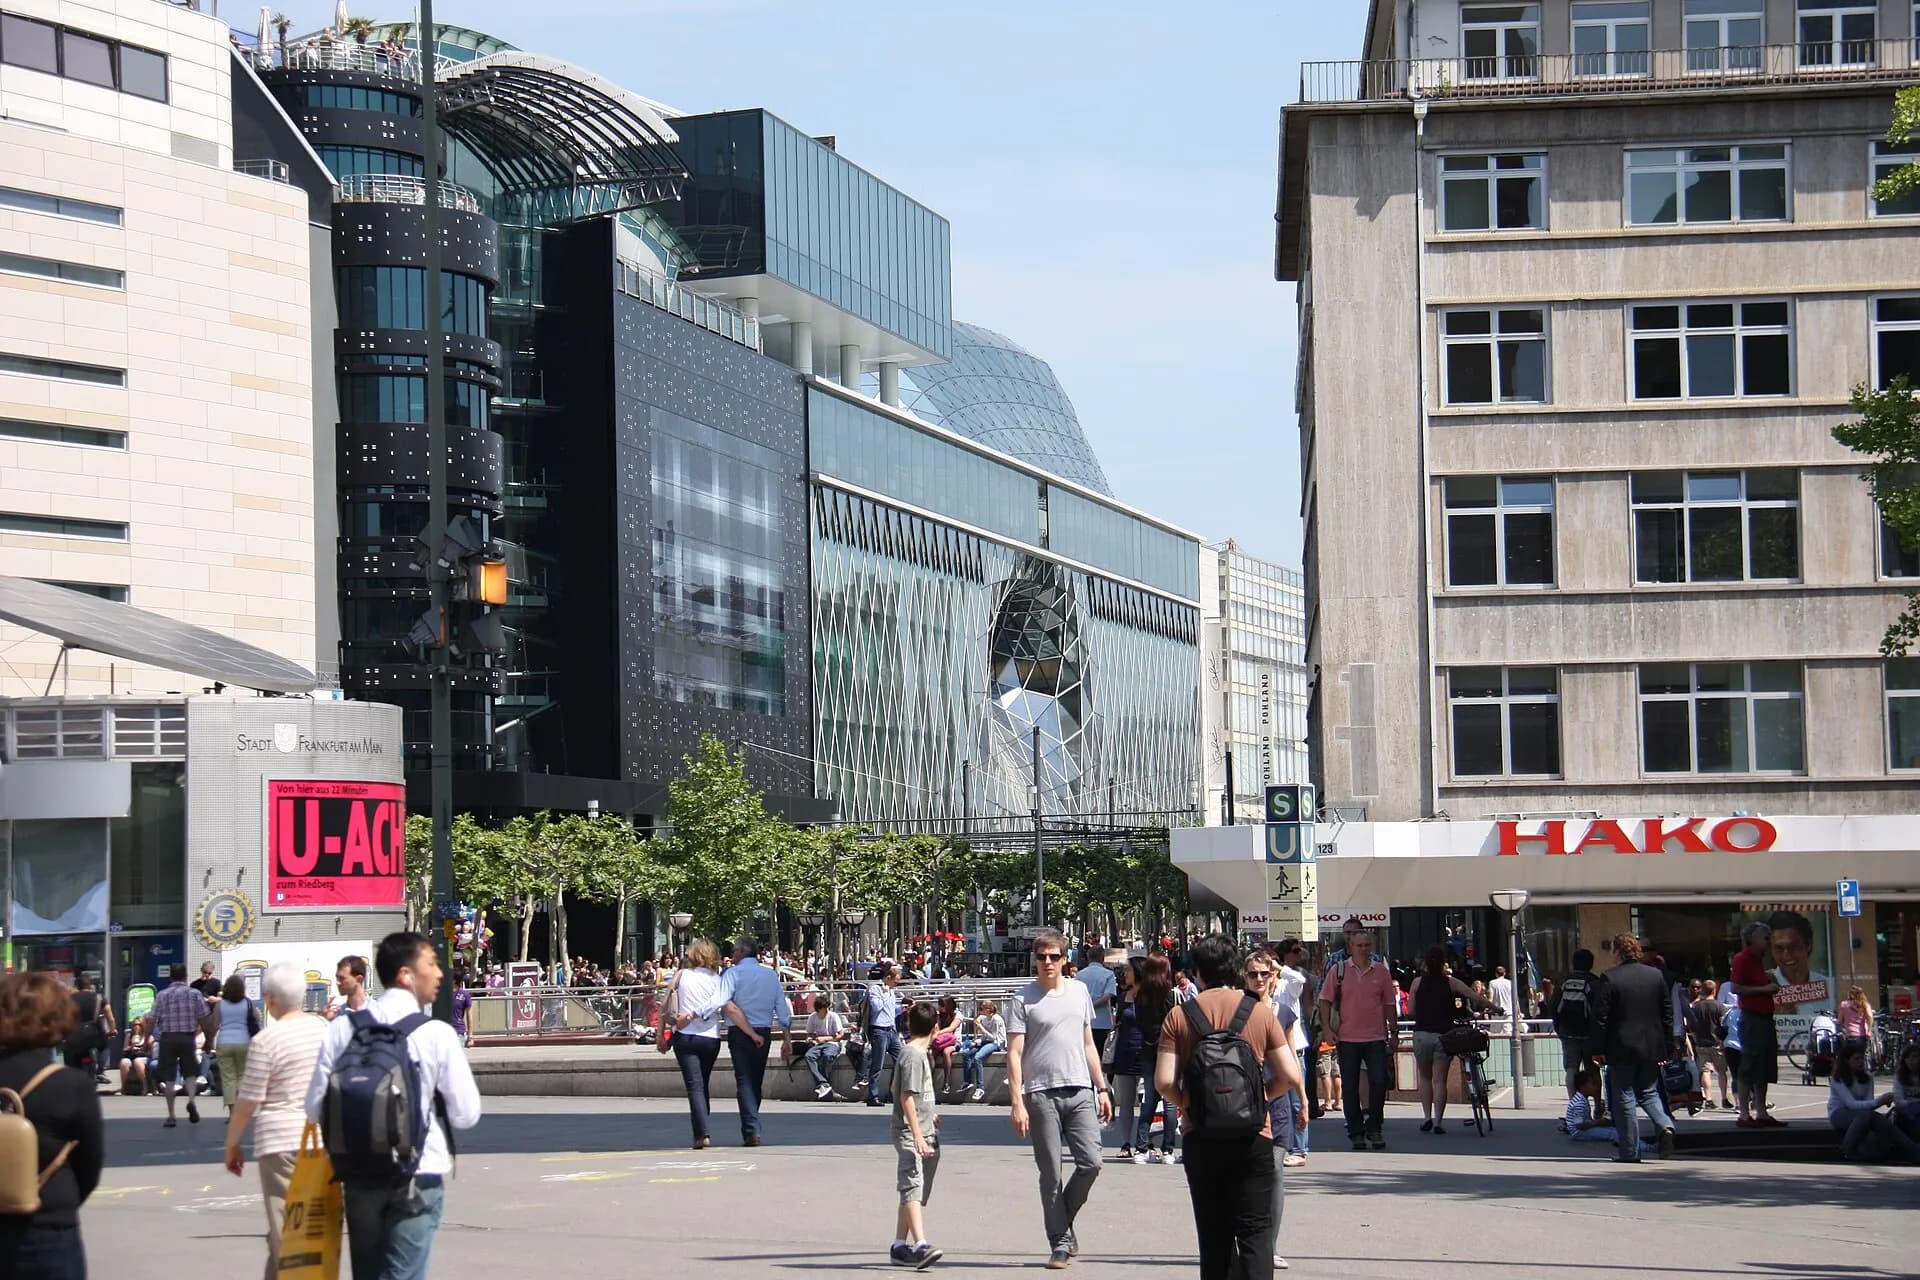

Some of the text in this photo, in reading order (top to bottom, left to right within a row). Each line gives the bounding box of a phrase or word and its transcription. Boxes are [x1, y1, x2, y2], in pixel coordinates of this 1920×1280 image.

[277, 784, 294, 793] Von
[297, 783, 313, 793] hier
[316, 786, 330, 794] aus
[332, 785, 340, 794] 22
[1274, 793, 1290, 816] S
[1303, 792, 1311, 816] S
[1270, 827, 1296, 859] U
[1301, 827, 1314, 859] U
[1497, 817, 1777, 856] HAKO
[1317, 844, 1333, 854] 123
[276, 879, 335, 891] zum Riedberg
[1840, 882, 1849, 896] P
[1350, 914, 1386, 922] HAKO
[1776, 981, 1825, 996] ENSCHUHE
[1781, 990, 1826, 1003] REDUZIERT
[1776, 1016, 1805, 1027] ehen
